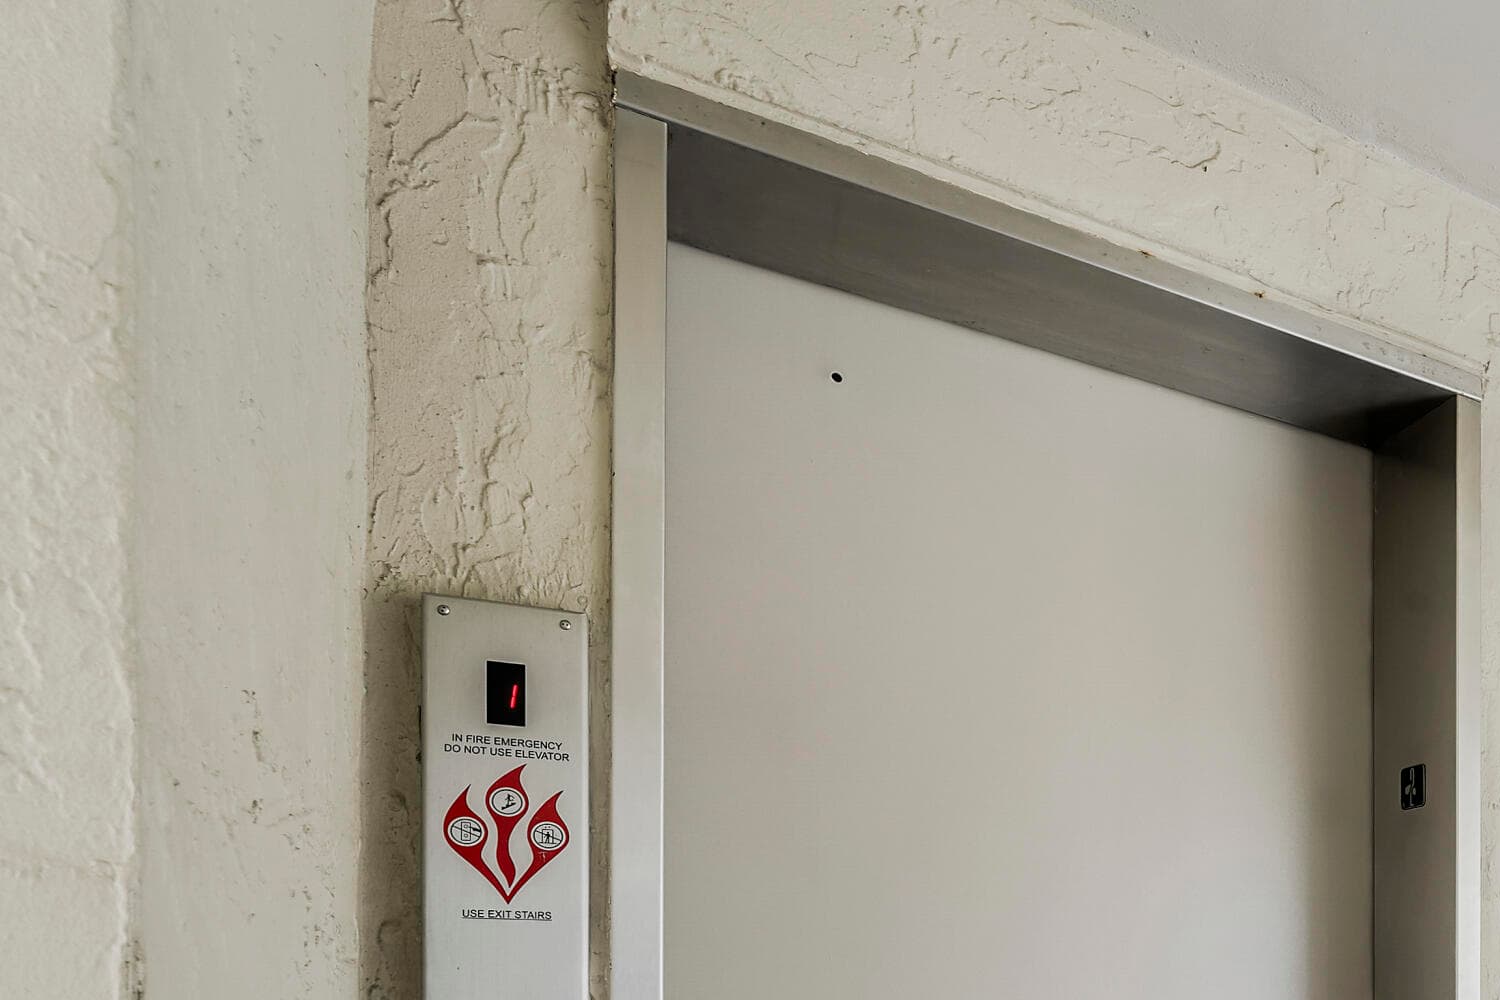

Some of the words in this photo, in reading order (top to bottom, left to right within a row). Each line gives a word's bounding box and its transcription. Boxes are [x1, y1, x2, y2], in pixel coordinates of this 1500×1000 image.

[510, 684, 518, 709] 1
[451, 733, 463, 742] IN
[466, 734, 491, 745] FIRE
[494, 736, 563, 751] EMERGENCY
[444, 743, 461, 753] DO
[464, 745, 487, 755] NOT
[490, 747, 513, 757] USE
[515, 749, 570, 762] ELEVATOR
[462, 909, 485, 918] USE
[488, 909, 512, 919] EXIT
[514, 910, 552, 920] STAIRS
